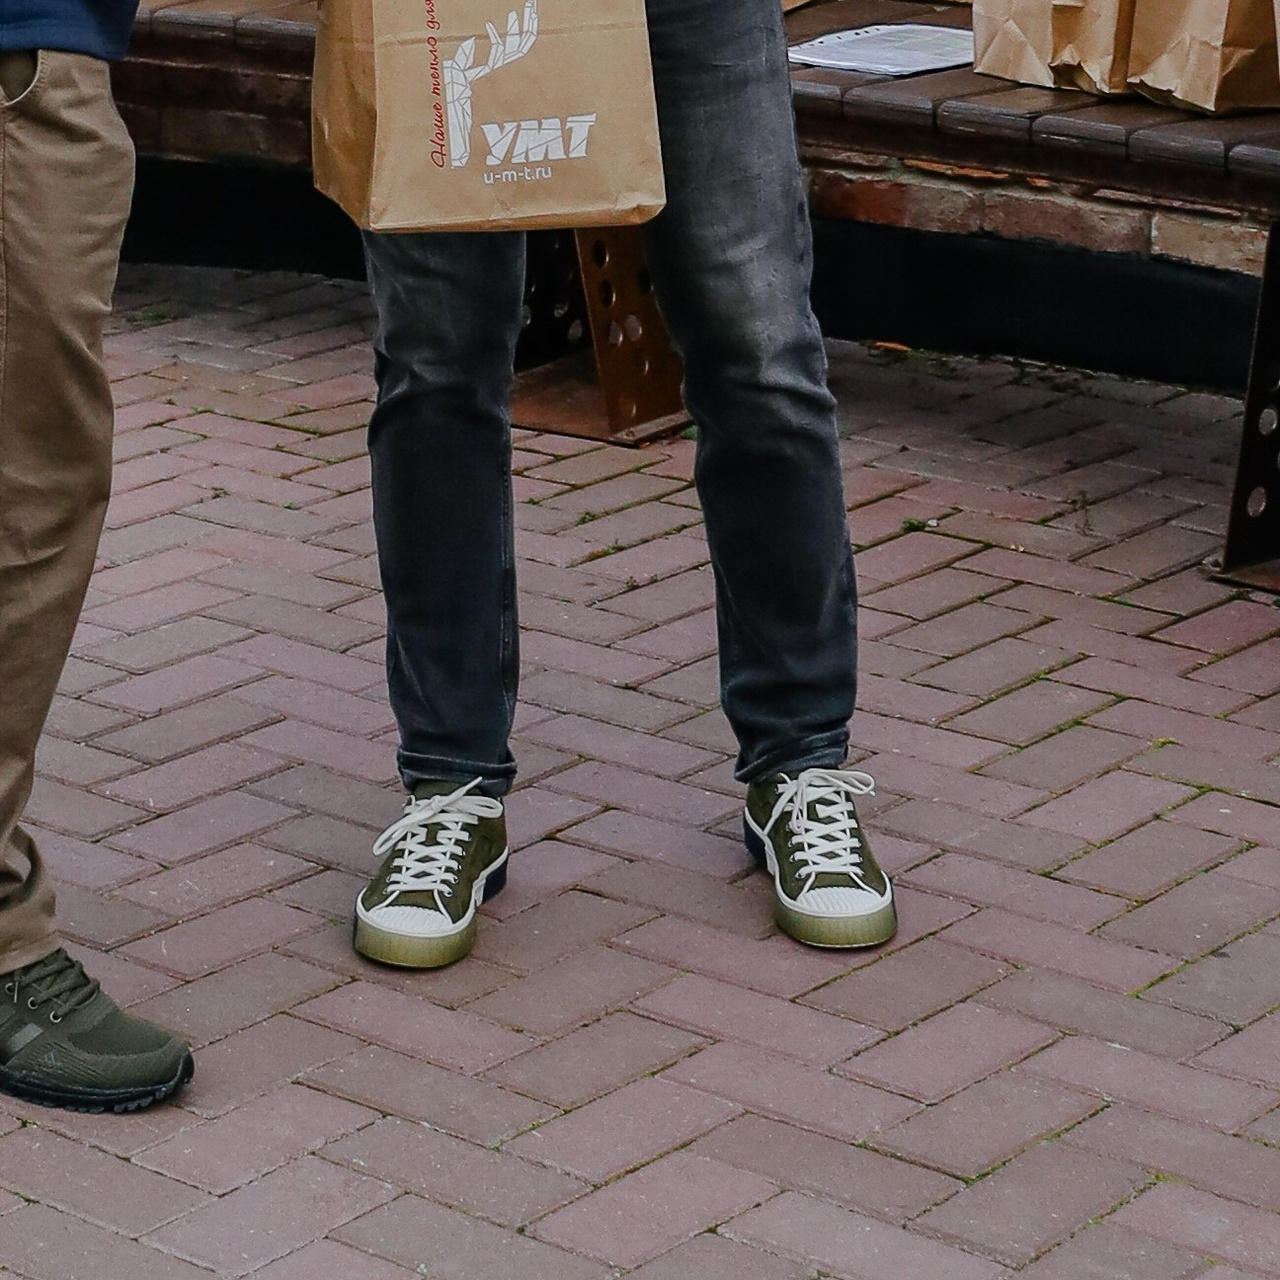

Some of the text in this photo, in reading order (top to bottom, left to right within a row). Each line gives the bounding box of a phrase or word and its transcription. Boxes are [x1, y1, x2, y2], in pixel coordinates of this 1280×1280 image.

[427, 36, 441, 96] тепло
[430, 102, 447, 169] Наше
[481, 113, 597, 165] УМТ
[483, 166, 552, 185] u-m-t.ru
